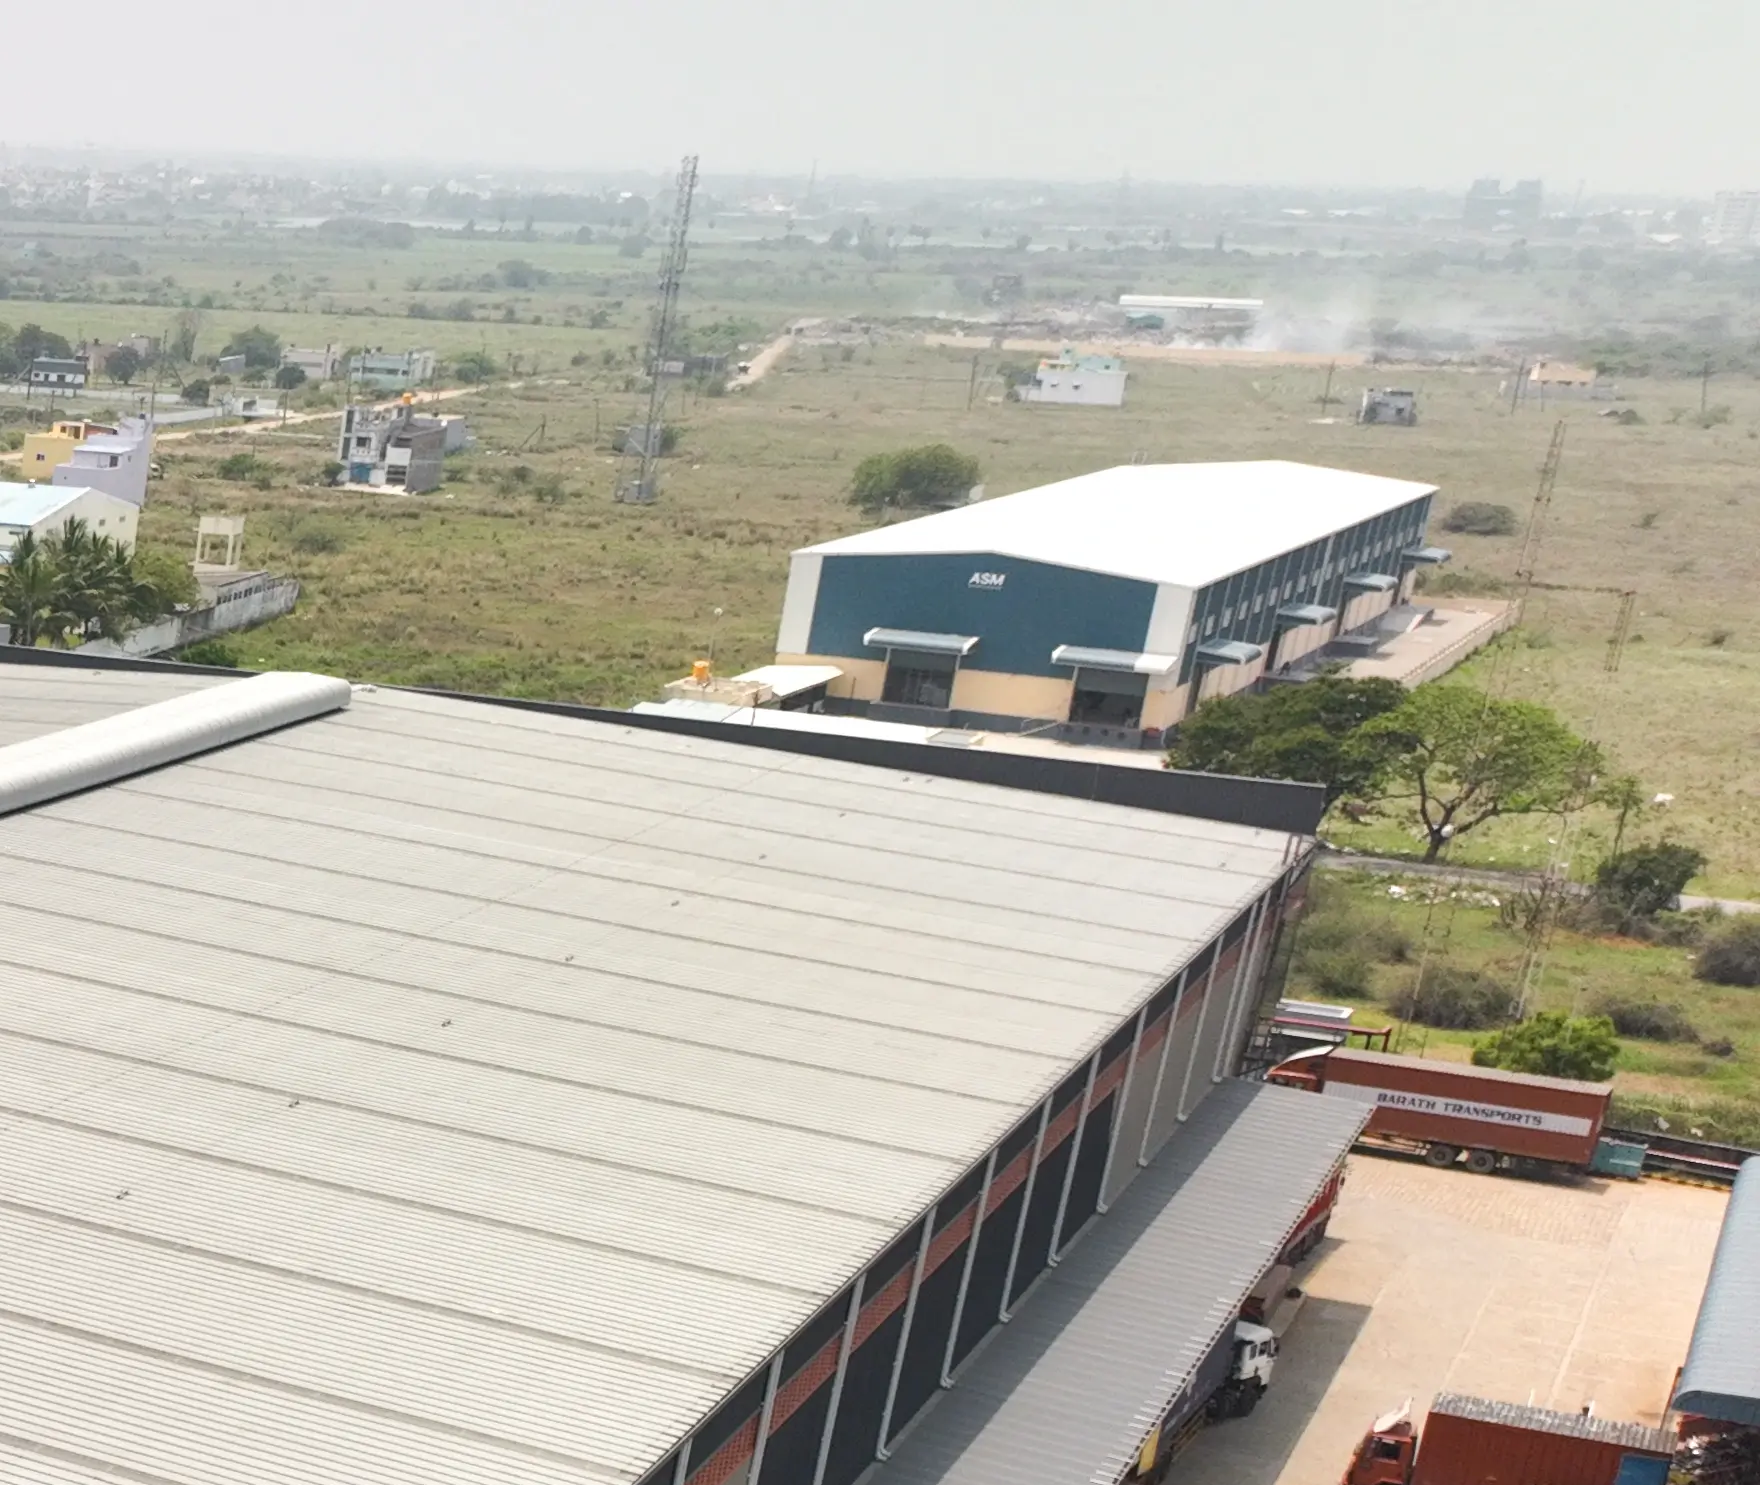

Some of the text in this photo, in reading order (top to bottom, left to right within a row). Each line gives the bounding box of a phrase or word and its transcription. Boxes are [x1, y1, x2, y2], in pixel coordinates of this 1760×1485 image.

[969, 571, 1006, 586] ASM
[1377, 1093, 1543, 1126] BARATH TRANSPORTS
